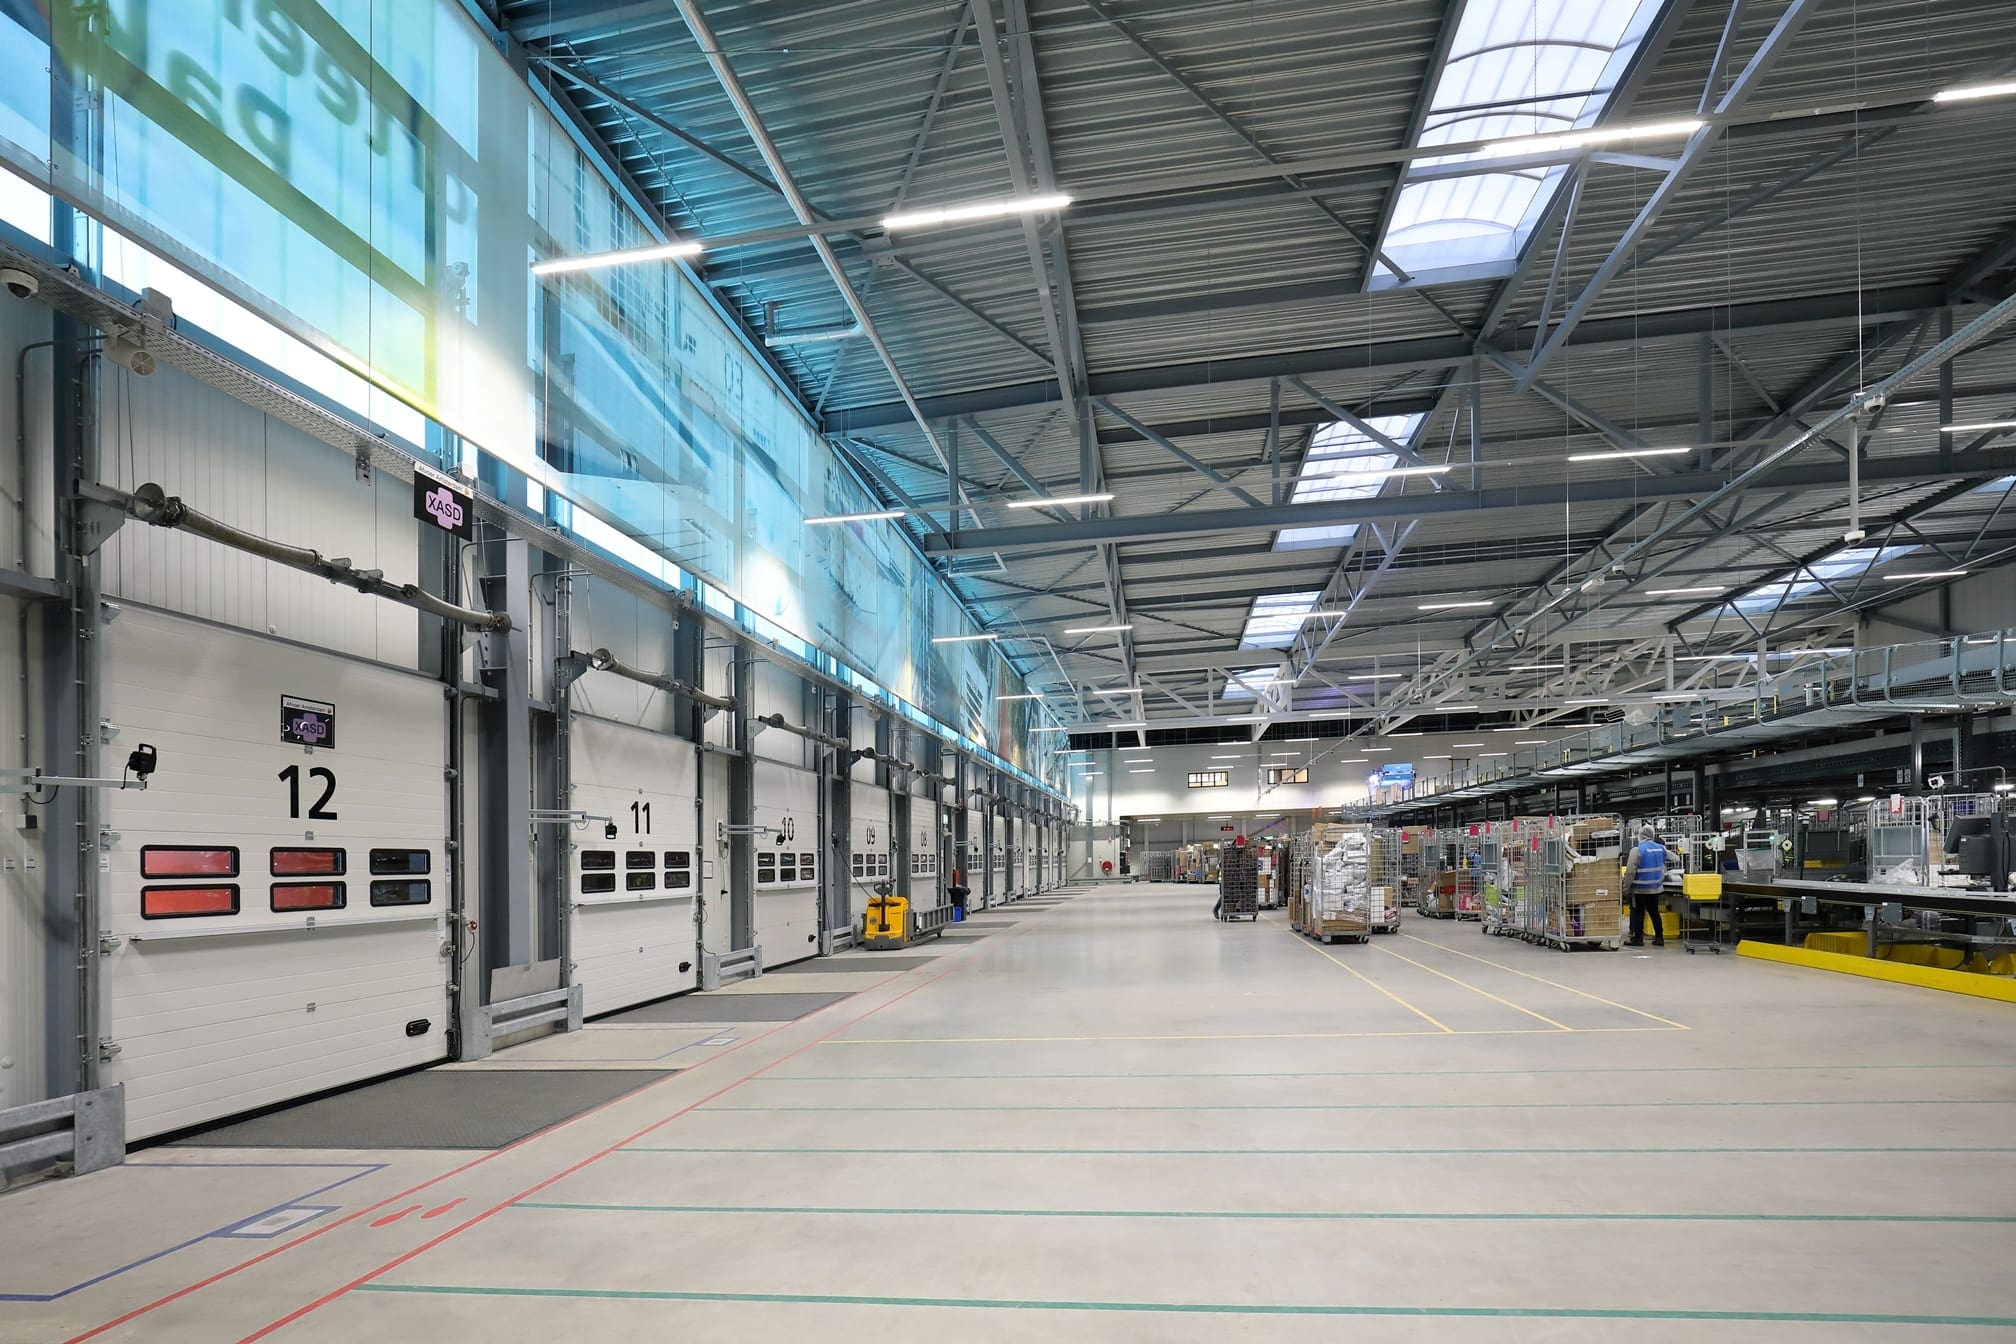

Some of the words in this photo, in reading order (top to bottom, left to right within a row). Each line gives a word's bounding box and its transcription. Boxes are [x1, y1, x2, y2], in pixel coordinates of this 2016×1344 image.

[428, 495, 461, 521] XASD
[295, 720, 325, 735] XASD
[278, 765, 338, 820] 12
[630, 801, 650, 835] 11
[781, 816, 795, 842] 10
[866, 827, 876, 845] 09
